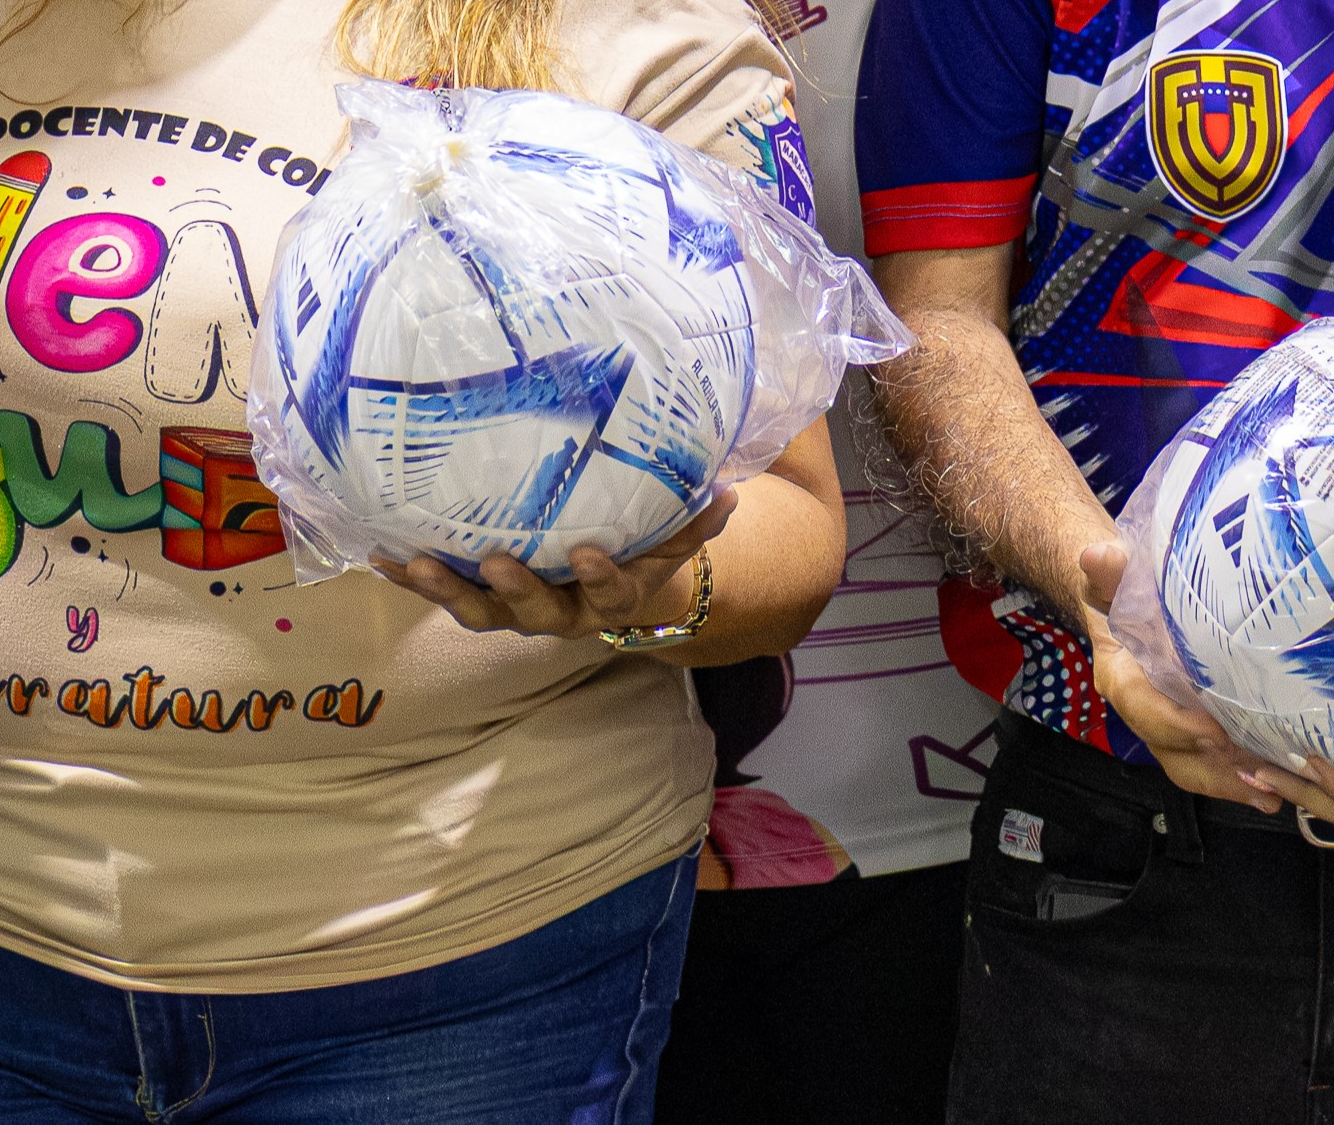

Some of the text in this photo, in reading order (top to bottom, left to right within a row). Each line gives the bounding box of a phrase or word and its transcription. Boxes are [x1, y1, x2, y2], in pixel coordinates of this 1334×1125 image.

[190, 121, 257, 162] DE
[691, 358, 703, 379] AL
[699, 375, 719, 413] RIHLA
[67, 605, 100, 652] y
